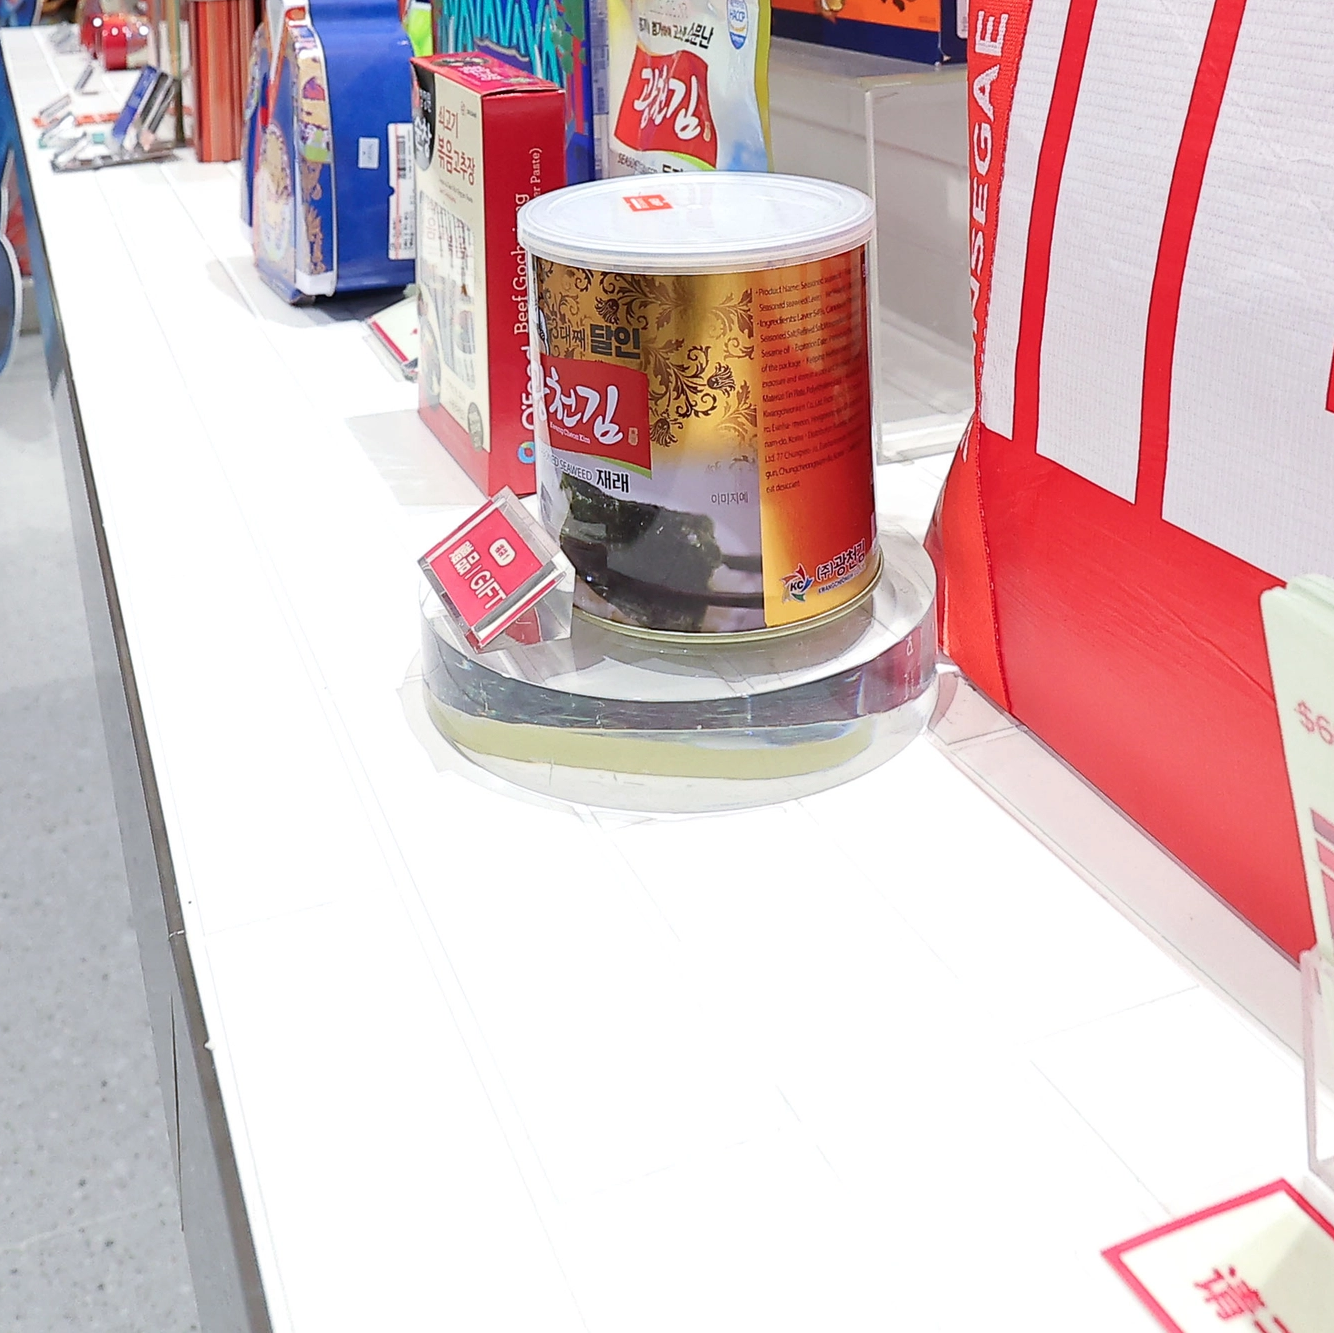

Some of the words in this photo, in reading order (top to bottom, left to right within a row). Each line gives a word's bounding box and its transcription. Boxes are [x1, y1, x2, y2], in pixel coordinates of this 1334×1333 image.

[437, 134, 475, 186] 볶음고추장
[589, 323, 641, 360] 달인
[761, 348, 783, 358] Sesame
[761, 364, 768, 373] of
[768, 364, 778, 372] the
[778, 360, 801, 372] package
[559, 459, 593, 481] SEAWEED
[596, 469, 629, 494] 재래
[711, 491, 749, 506] 이미지예
[816, 539, 866, 581] (주)광천김
[470, 570, 507, 610] GIFT
[790, 580, 804, 591] KC
